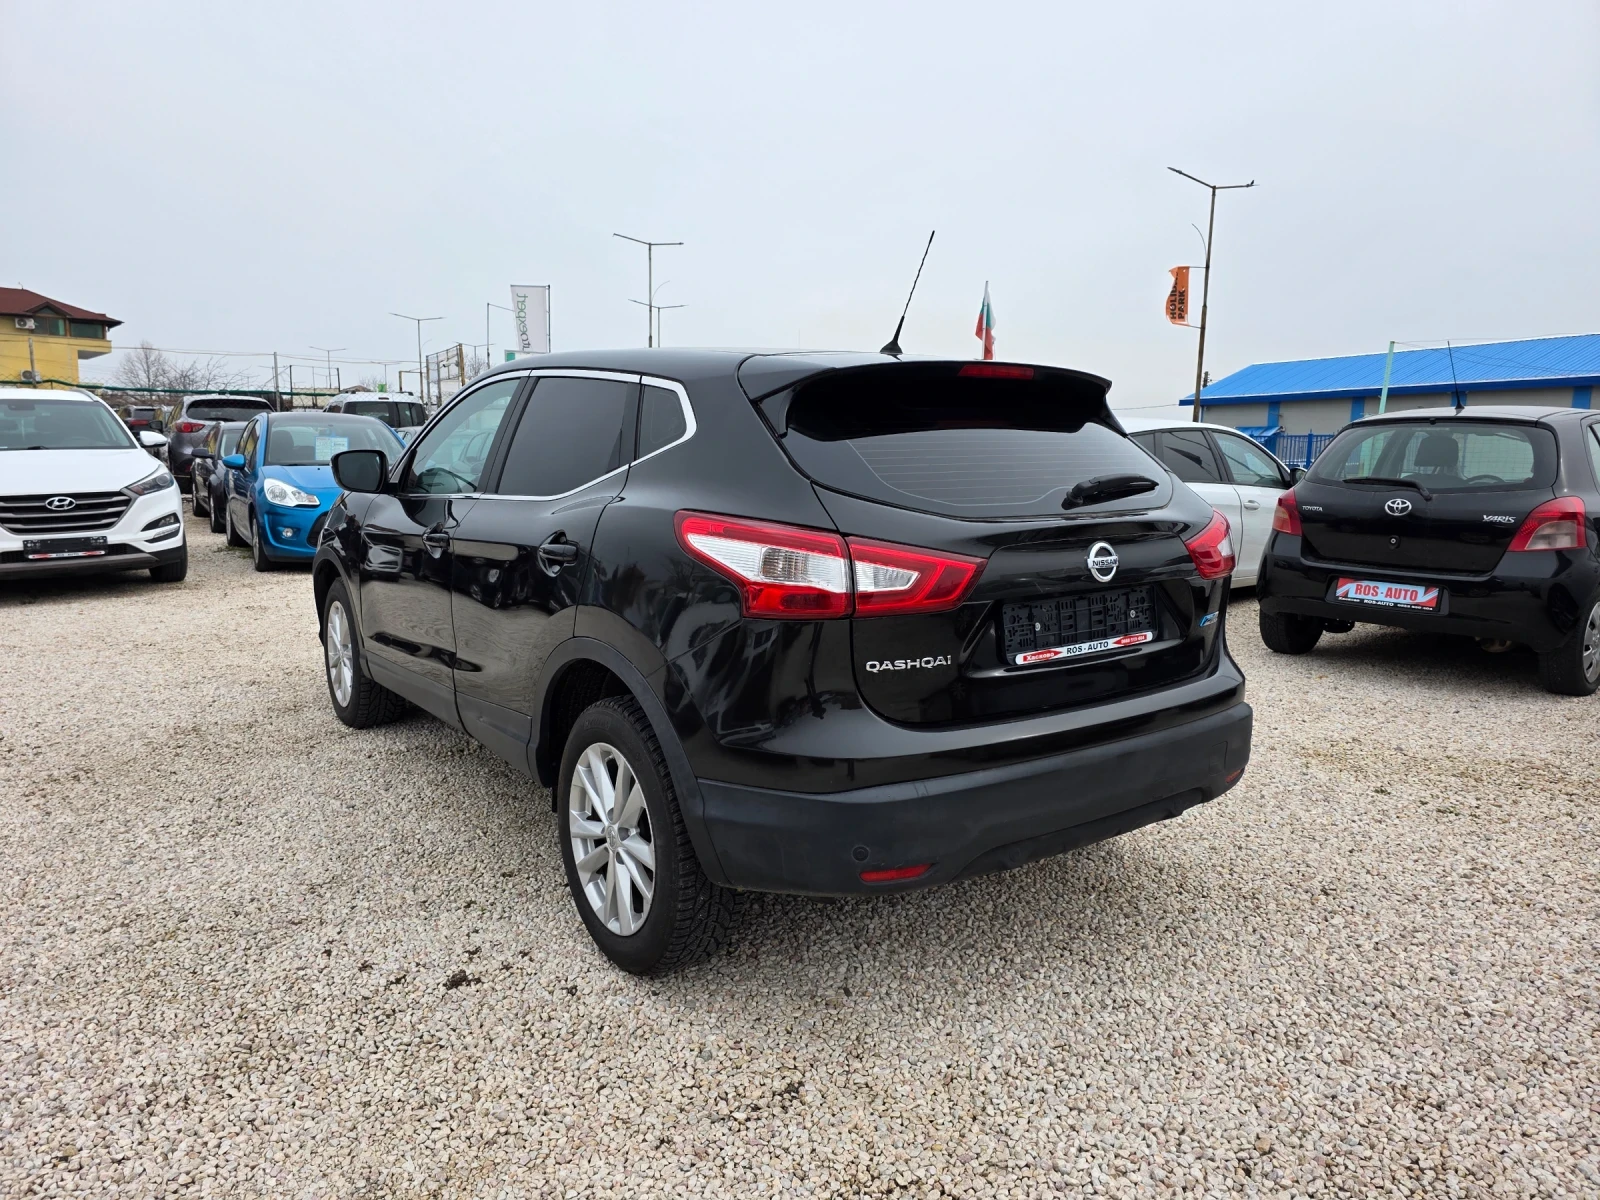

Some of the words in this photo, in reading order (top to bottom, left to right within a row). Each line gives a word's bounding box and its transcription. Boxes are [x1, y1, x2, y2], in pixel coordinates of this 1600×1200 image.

[1169, 272, 1179, 320] HOLID
[1178, 289, 1186, 320] PARK
[1482, 514, 1517, 524] YARIS
[1092, 557, 1118, 567] NISSAN
[865, 655, 952, 673] QASHQAI
